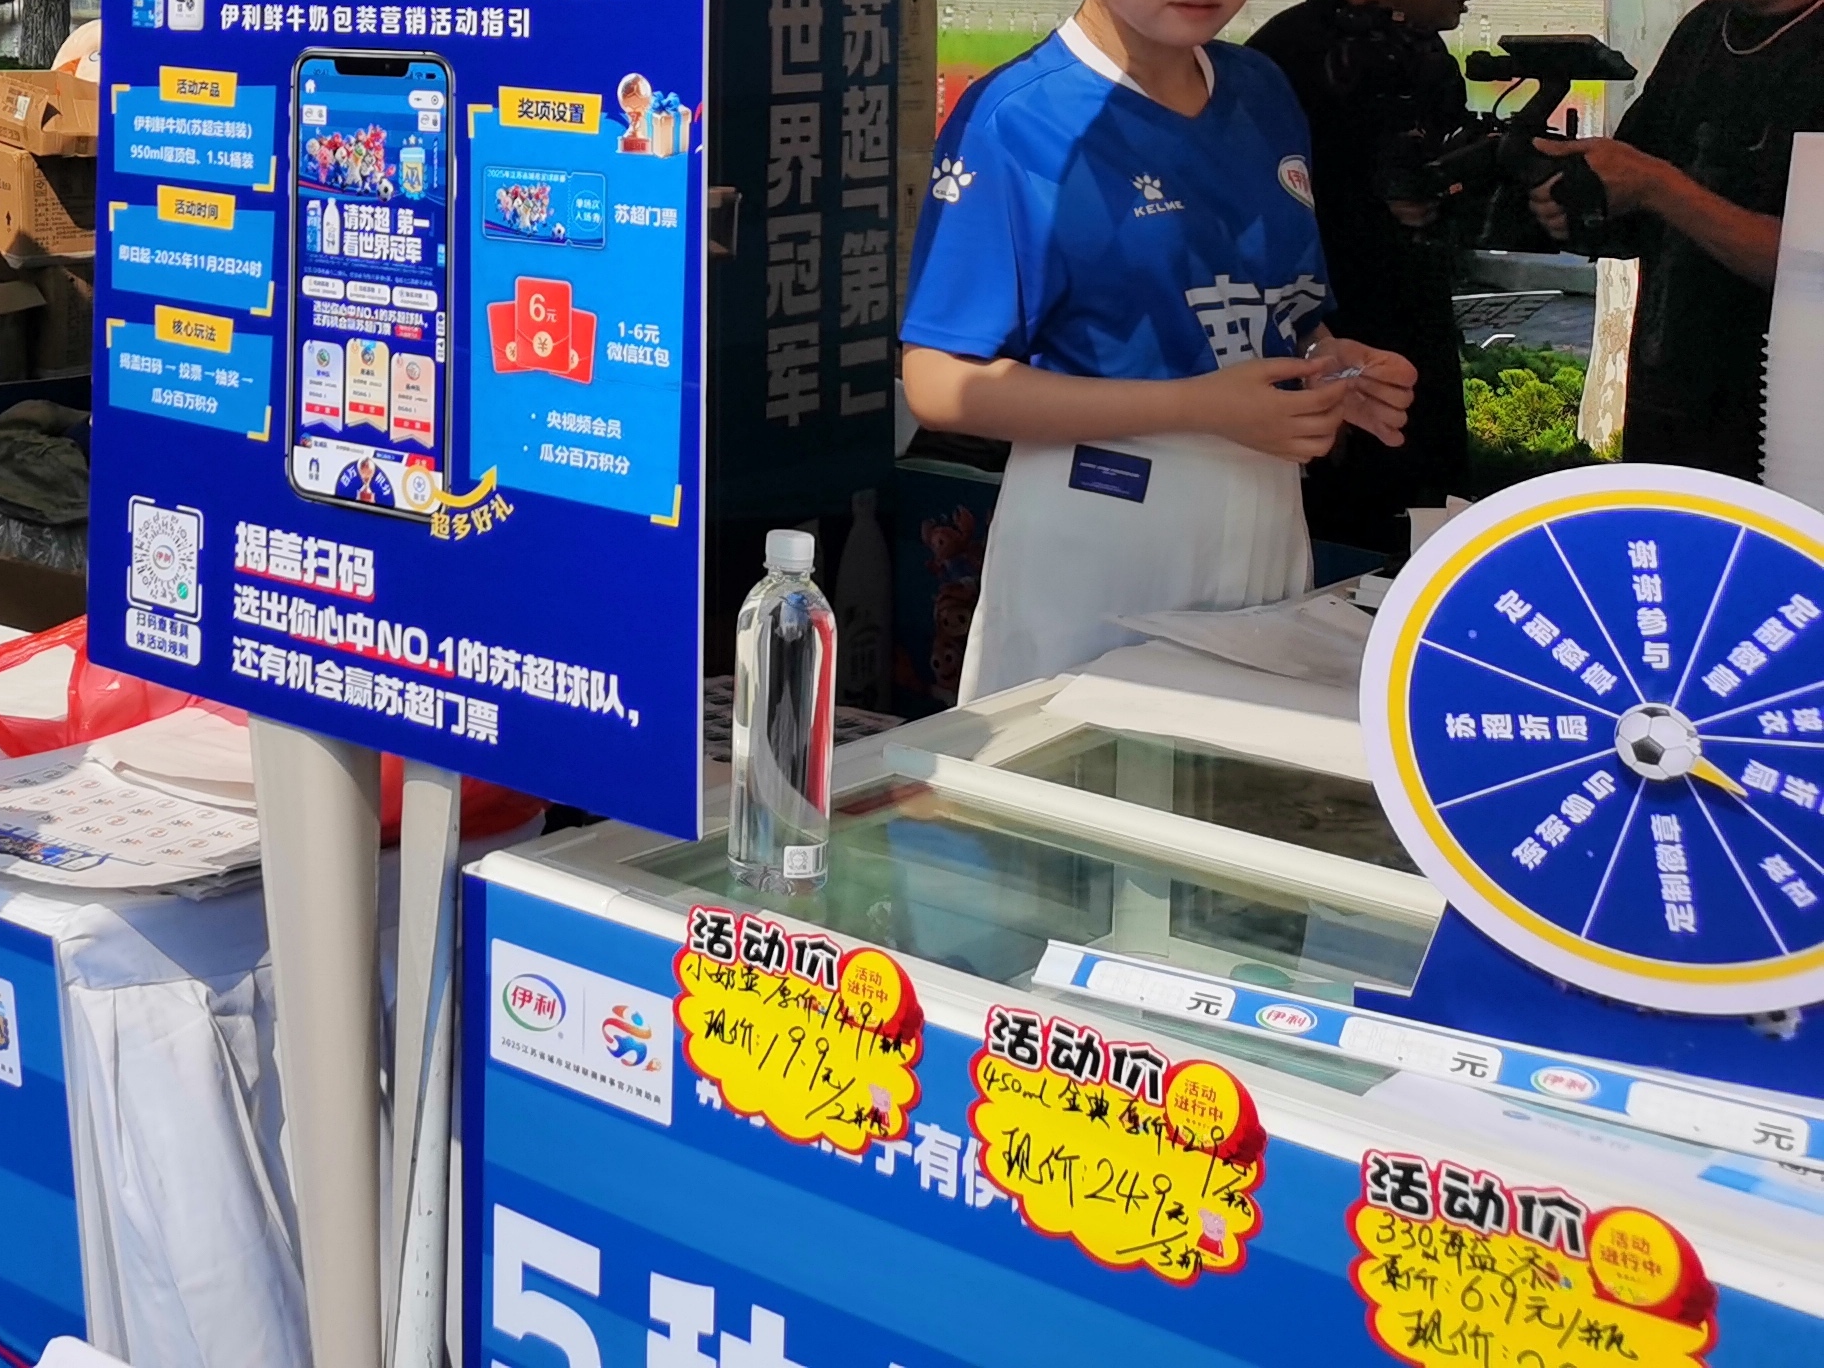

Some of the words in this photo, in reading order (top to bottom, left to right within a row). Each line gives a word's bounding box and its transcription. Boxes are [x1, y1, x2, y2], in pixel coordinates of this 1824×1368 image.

[220, 3, 531, 38] 伊利鲜牛奶包装营销活动指引
[176, 78, 220, 98] 活动产品
[517, 97, 585, 124] 奖项设置
[174, 198, 219, 221] 活动时间
[613, 203, 678, 228] 苏超门票
[1133, 199, 1186, 218] KELME
[118, 244, 263, 278] 即日起-2025年11月2日24时
[343, 231, 423, 264] 看世界冠军
[528, 293, 558, 323] 6元
[172, 318, 217, 342] 核心玩法
[617, 321, 661, 344] 1-6元
[119, 352, 163, 375] 揭盖扫码
[178, 362, 203, 381] 投票
[606, 341, 671, 368] 微信红包
[151, 387, 219, 414] 瓜分百万积分
[546, 410, 623, 440] 央视频会员
[539, 443, 631, 475] 瓜分百万积分
[429, 493, 515, 542] 超多好礼
[234, 519, 376, 596] 揭盖扫码
[1627, 538, 1672, 670] 谢谢参与
[135, 611, 189, 640] 扫码查看具
[135, 630, 189, 660] 体活动规则
[1493, 589, 1620, 697] 定制徽章
[1701, 593, 1823, 698] 定制徽章
[230, 635, 500, 745] 还有机会赢苏超门票
[1444, 712, 1590, 741] 苏超折扇
[1740, 757, 1824, 815] 折扇
[1512, 769, 1617, 872] 谢谢参与
[1650, 812, 1699, 934] 定制徽章
[688, 911, 840, 988] 活动价
[847, 980, 889, 1003] 进行中
[854, 966, 882, 987] 活动
[510, 985, 557, 1020] 伊利
[1185, 990, 1224, 1017] 元
[1265, 1007, 1308, 1028] 伊利
[989, 1010, 1167, 1103] 活动价
[1449, 1051, 1490, 1078] 元
[1184, 1078, 1217, 1102] 活动
[1173, 1095, 1224, 1122] 进行中
[1752, 1121, 1796, 1152] 元
[1366, 1158, 1588, 1254] 活动价
[1610, 1227, 1650, 1255] 活动
[1598, 1243, 1663, 1279] 进行中
